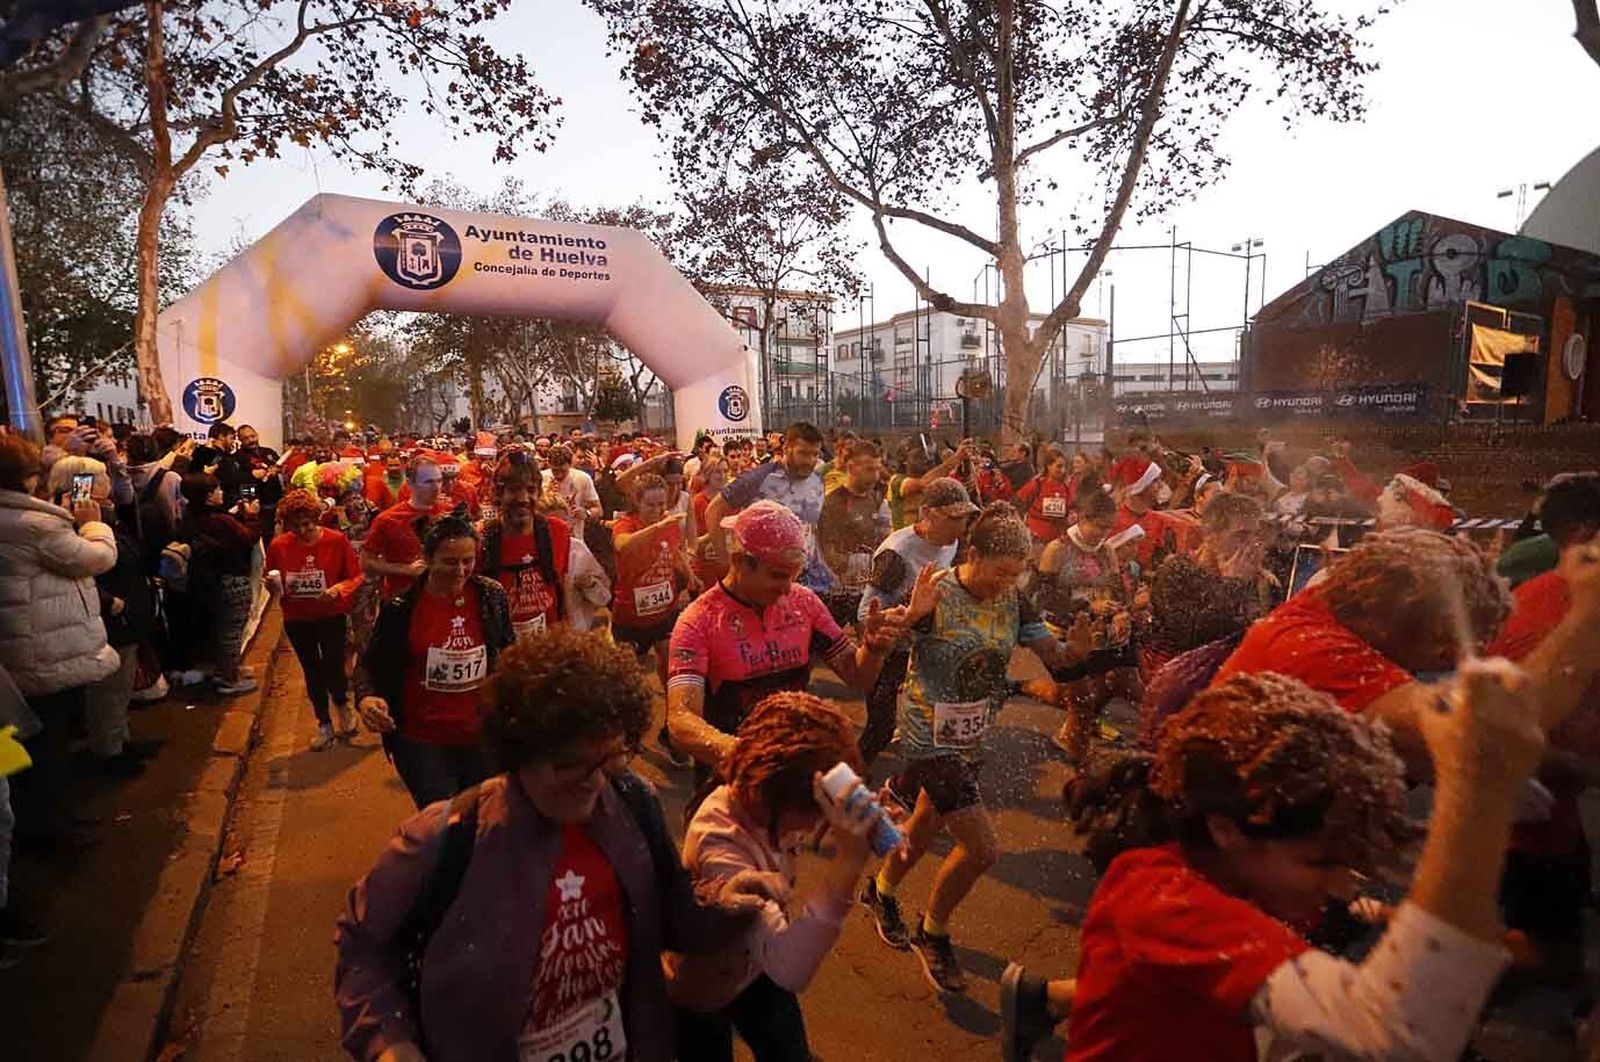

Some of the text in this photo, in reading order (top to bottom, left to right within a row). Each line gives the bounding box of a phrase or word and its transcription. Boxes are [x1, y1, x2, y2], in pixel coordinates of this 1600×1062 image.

[465, 225, 606, 250] Ayuntamiento
[509, 245, 607, 266] de Huelva
[542, 267, 556, 276] de
[559, 268, 610, 281] Deportes
[1273, 397, 1321, 406] HYUNDAI
[1358, 392, 1417, 404] HYUNDAI
[453, 660, 482, 680] 517
[547, 1026, 613, 1062] 98
